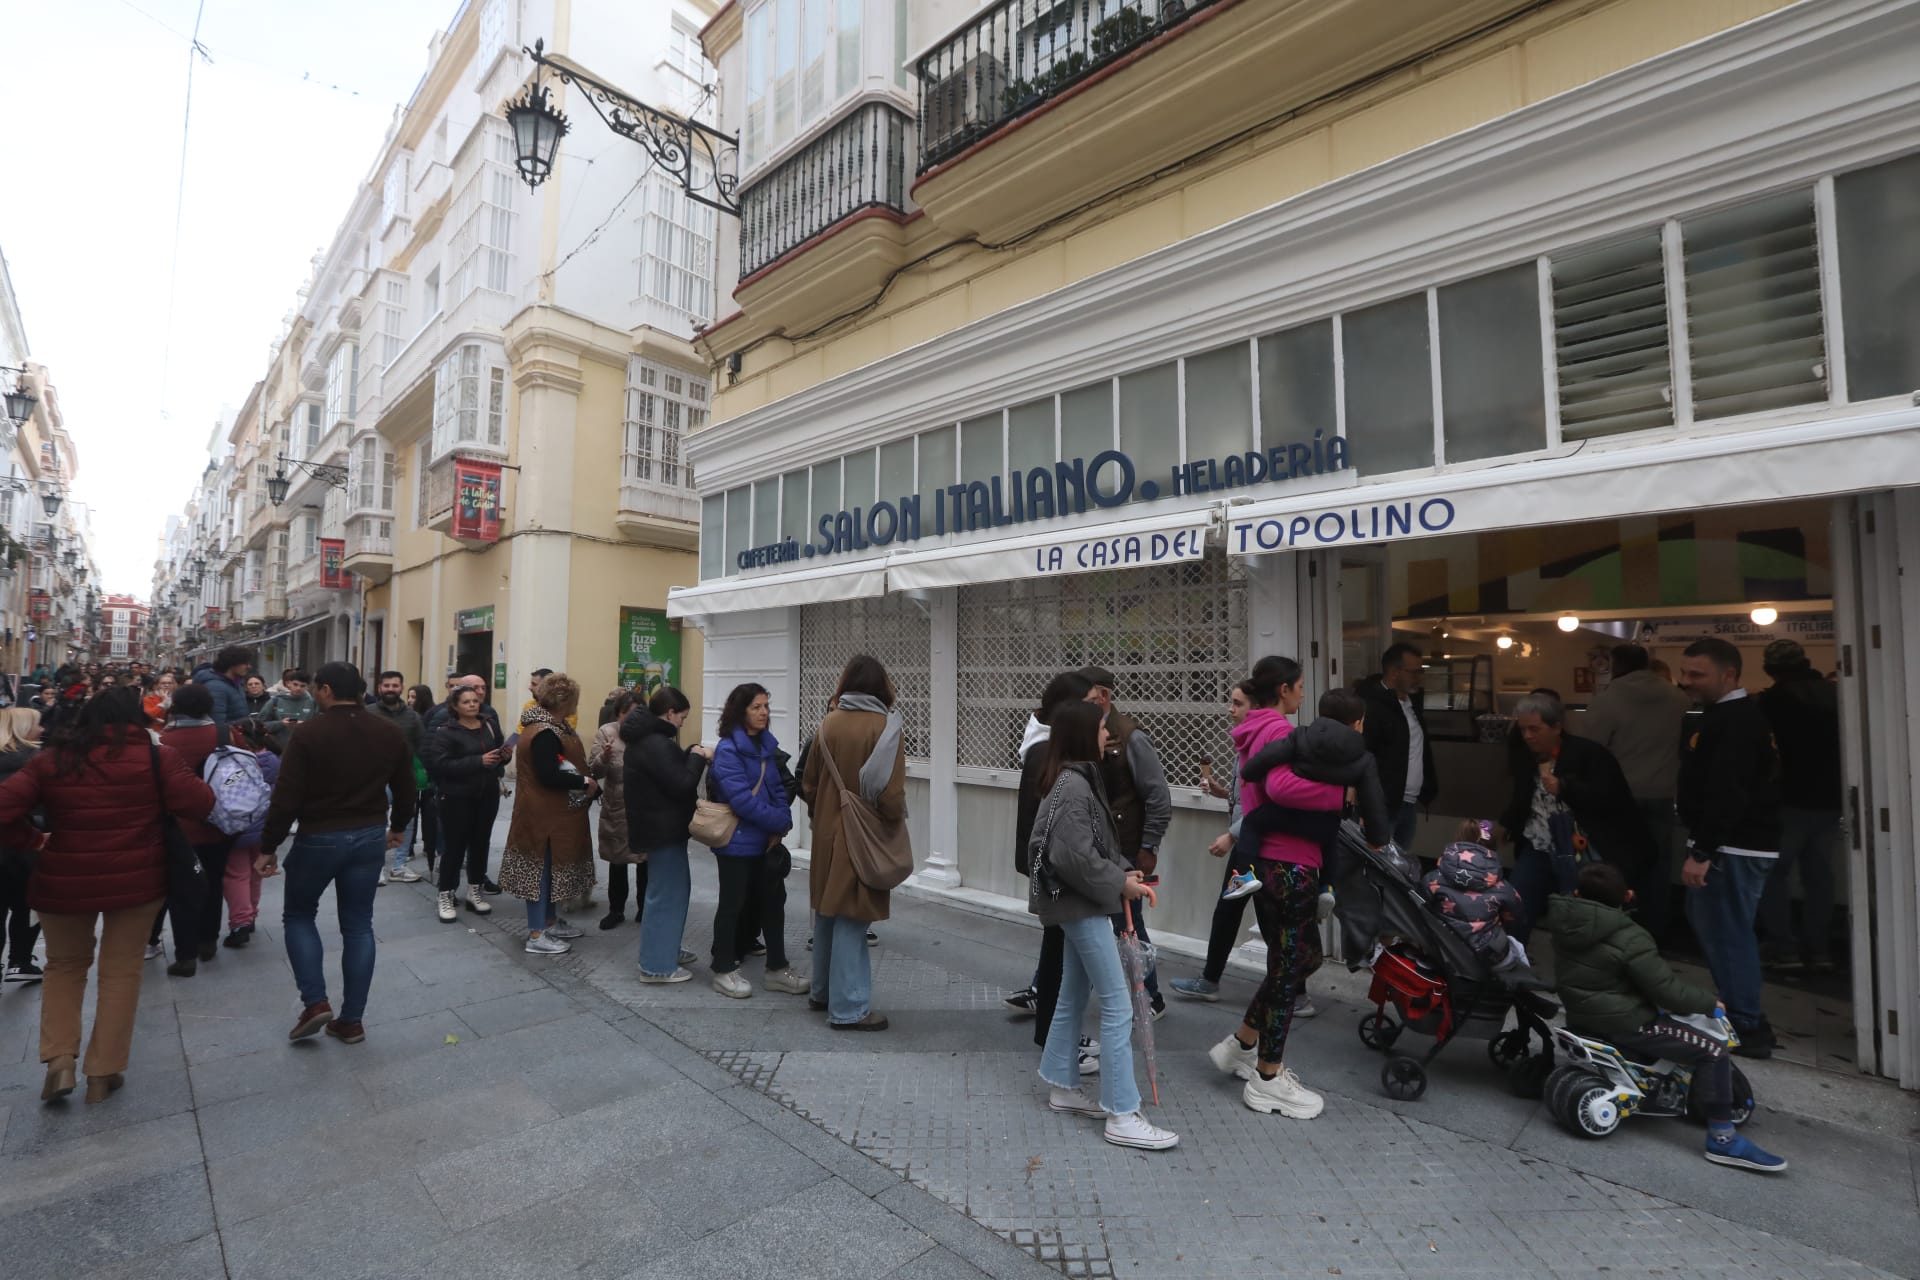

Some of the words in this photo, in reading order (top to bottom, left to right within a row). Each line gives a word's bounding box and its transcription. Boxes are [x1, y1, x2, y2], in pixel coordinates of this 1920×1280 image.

[737, 536, 799, 570] CAFETERÍA
[818, 493, 921, 556] SALON
[936, 450, 1135, 536] ITALIANO
[1172, 428, 1349, 496] HELADERÍA
[1036, 546, 1063, 572] LA
[1077, 536, 1141, 568] CASA
[1151, 529, 1199, 561] DEL
[1234, 498, 1455, 552] TOPOLINO
[631, 631, 657, 645] fuze
[631, 643, 652, 653] tea
